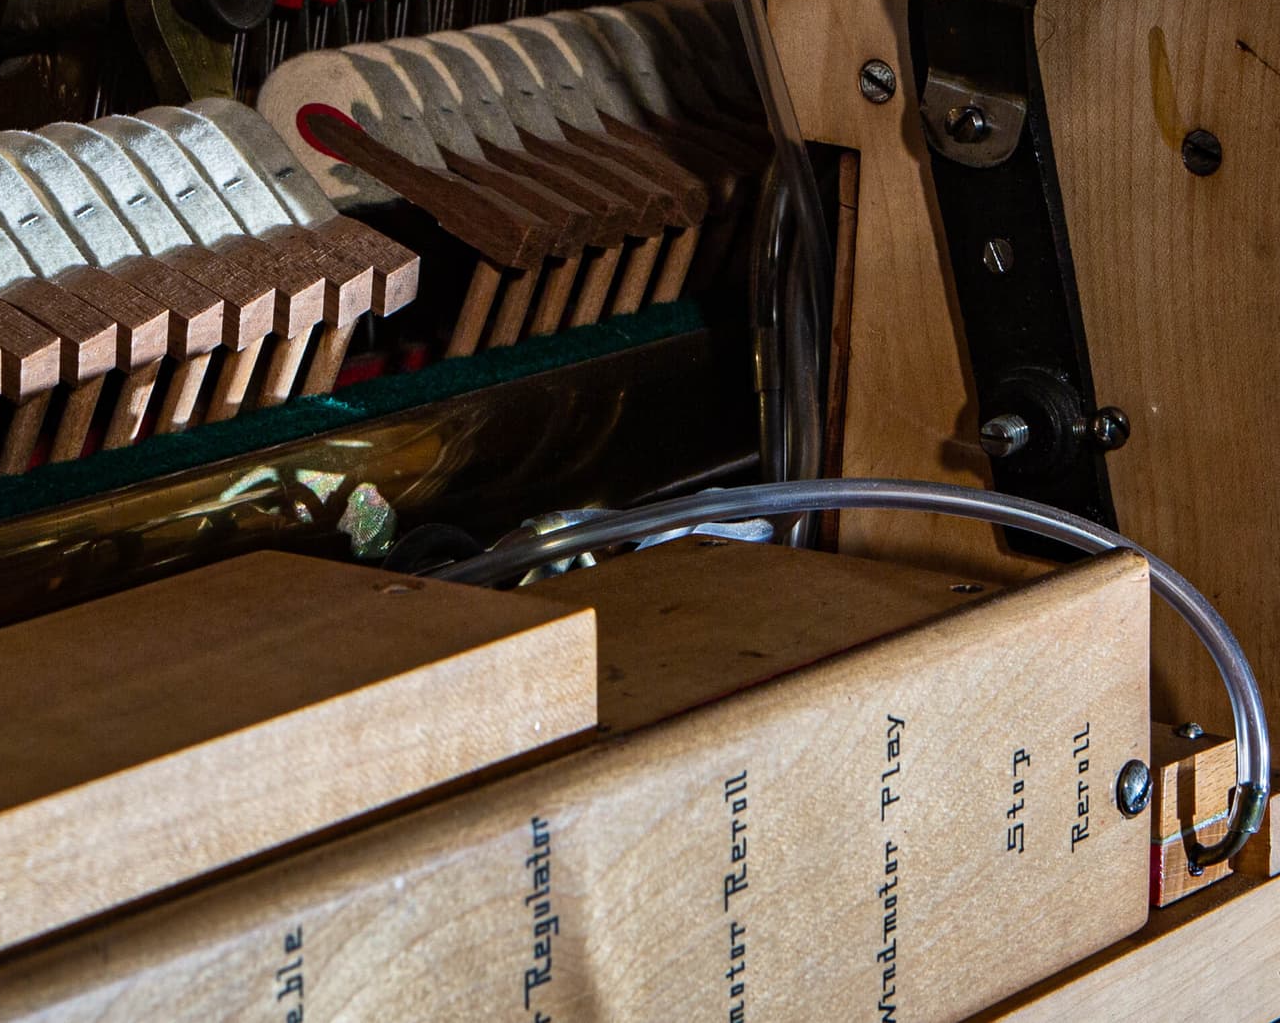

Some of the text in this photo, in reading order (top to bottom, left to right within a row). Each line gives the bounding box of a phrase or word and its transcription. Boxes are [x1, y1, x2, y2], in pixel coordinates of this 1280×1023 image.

[881, 713, 906, 822] Play
[1007, 748, 1031, 854] Stop
[1071, 721, 1090, 853] Reroll
[724, 769, 749, 913] Reroll
[524, 815, 560, 1010] Regulator
